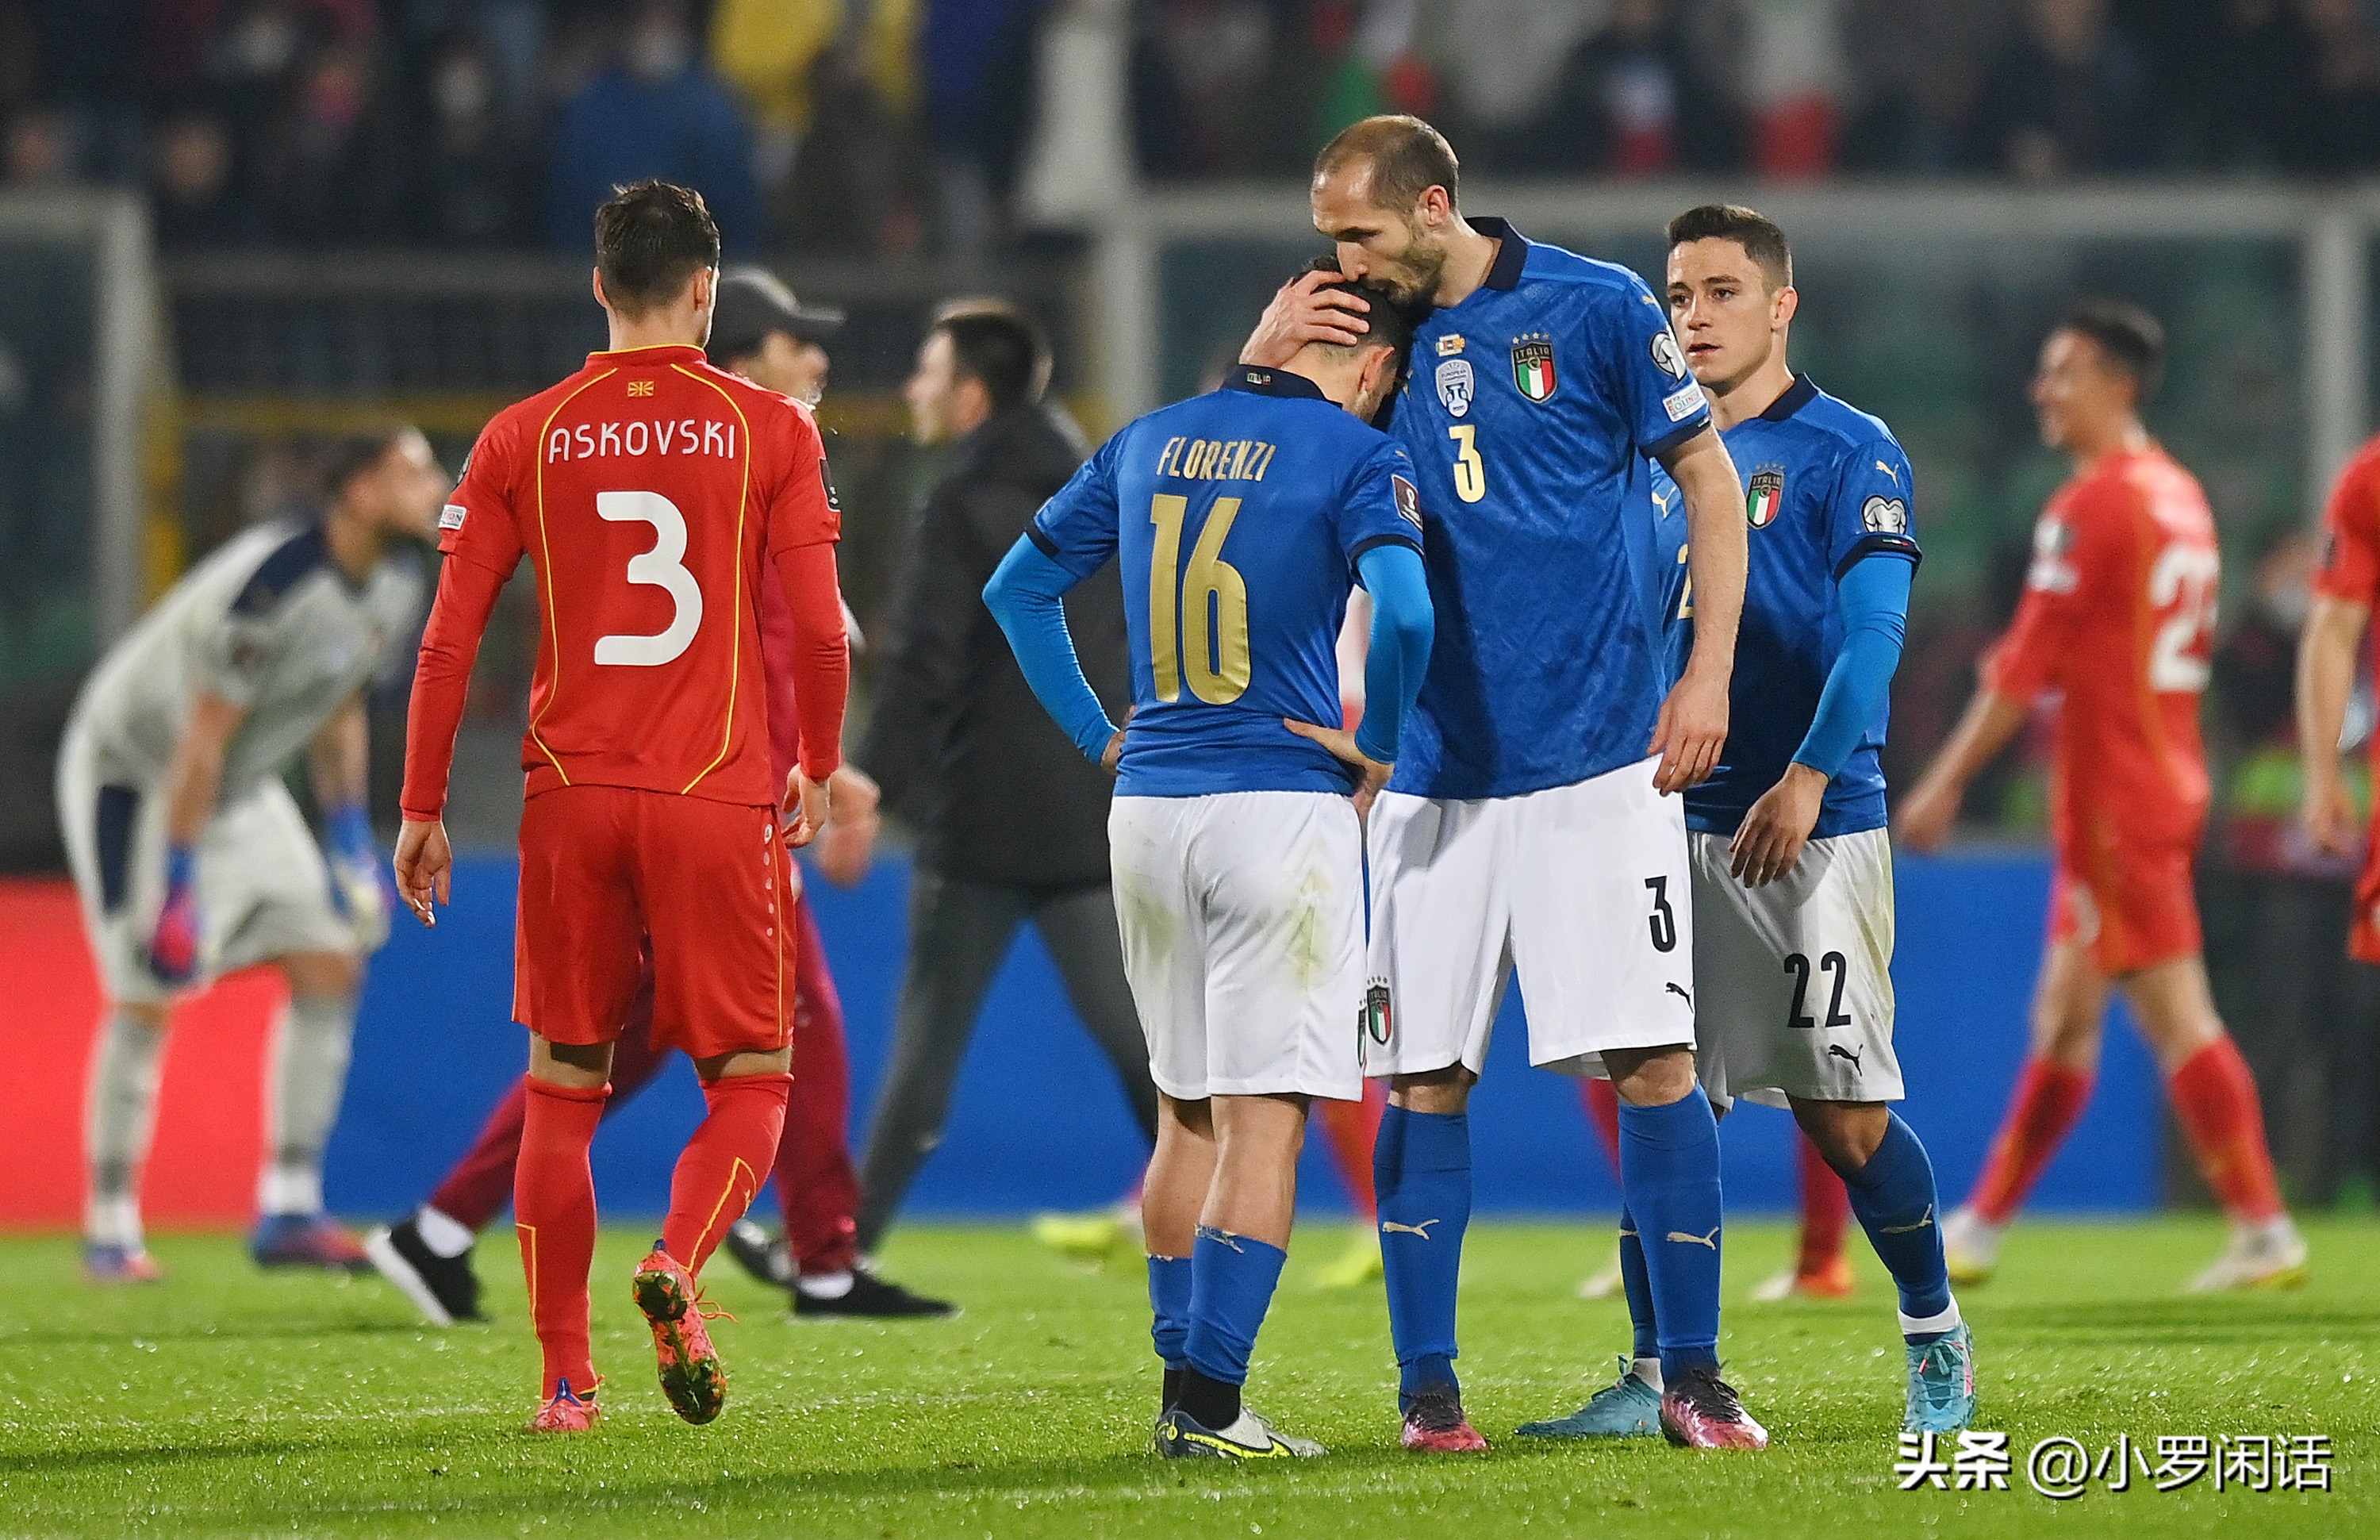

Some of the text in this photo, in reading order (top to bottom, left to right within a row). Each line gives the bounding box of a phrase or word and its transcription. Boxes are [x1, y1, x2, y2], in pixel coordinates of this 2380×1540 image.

[1515, 346, 1550, 359] ITALIA
[548, 419, 736, 464] ASKOVSKI
[1157, 436, 1276, 482] FLORENZI
[1448, 424, 1486, 503] 3
[1753, 476, 1781, 486] ITALIA
[594, 490, 703, 666] 3
[1149, 493, 1252, 705] 16
[1645, 874, 1677, 953] 3
[1784, 950, 1852, 1029] 22
